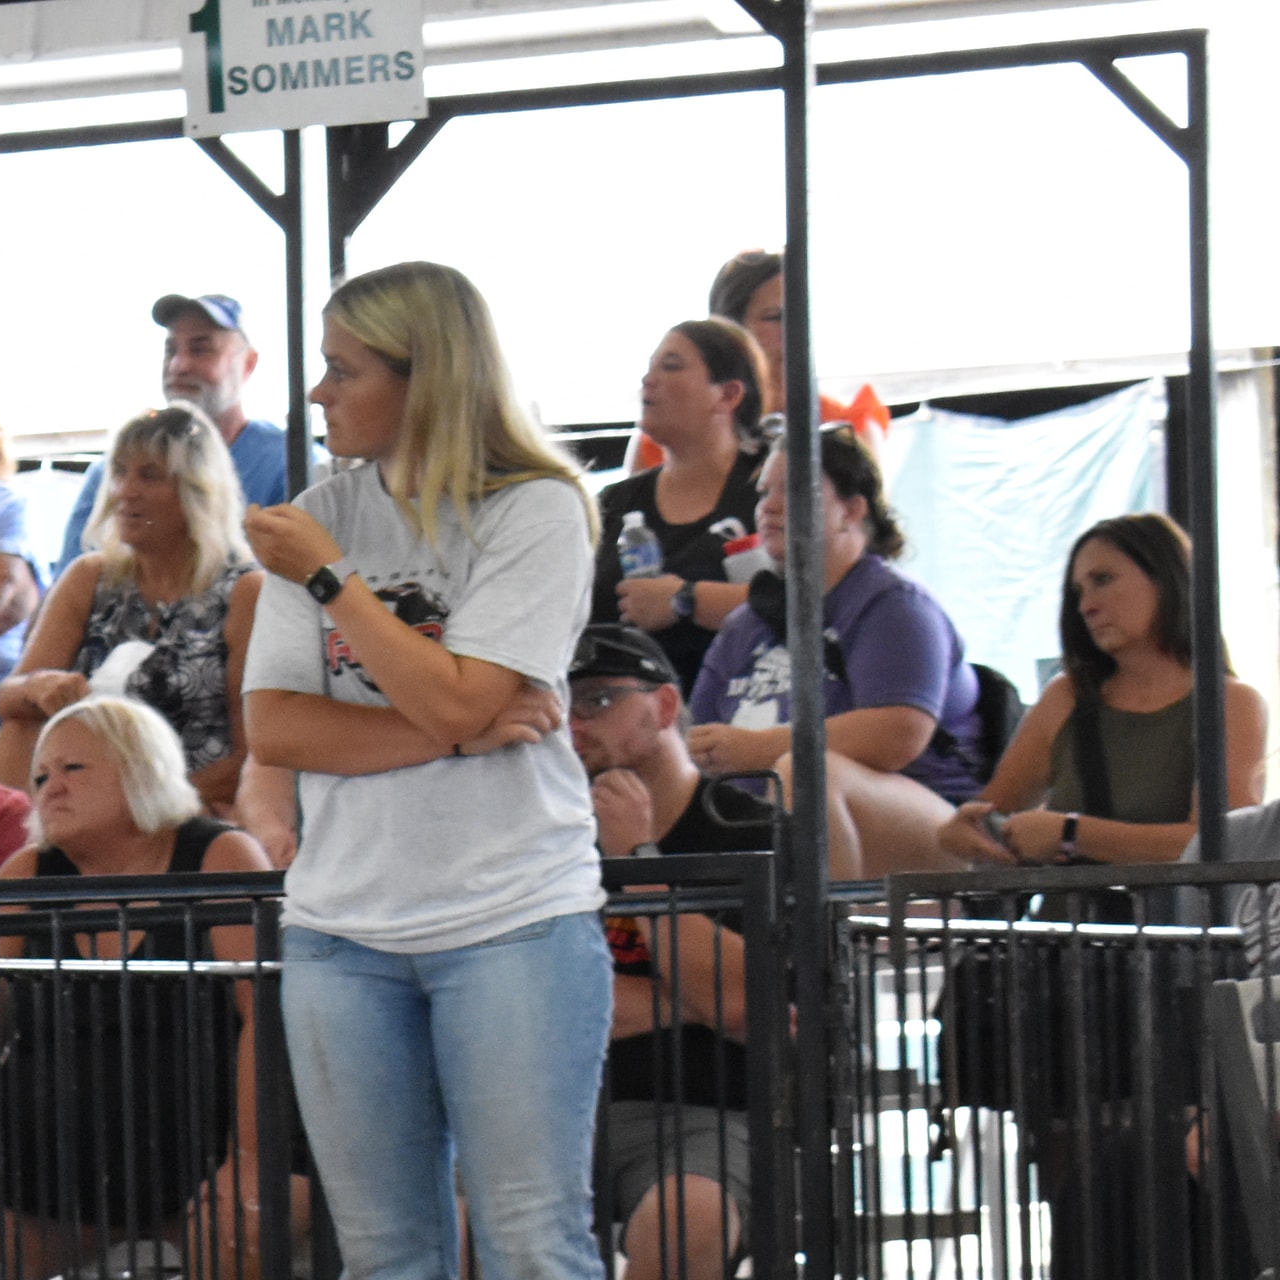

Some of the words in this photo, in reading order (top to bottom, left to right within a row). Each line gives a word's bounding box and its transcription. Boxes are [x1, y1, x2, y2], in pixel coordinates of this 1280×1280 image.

[266, 9, 375, 48] MARK
[188, 0, 225, 113] 1
[227, 50, 416, 96] SOMMERS
